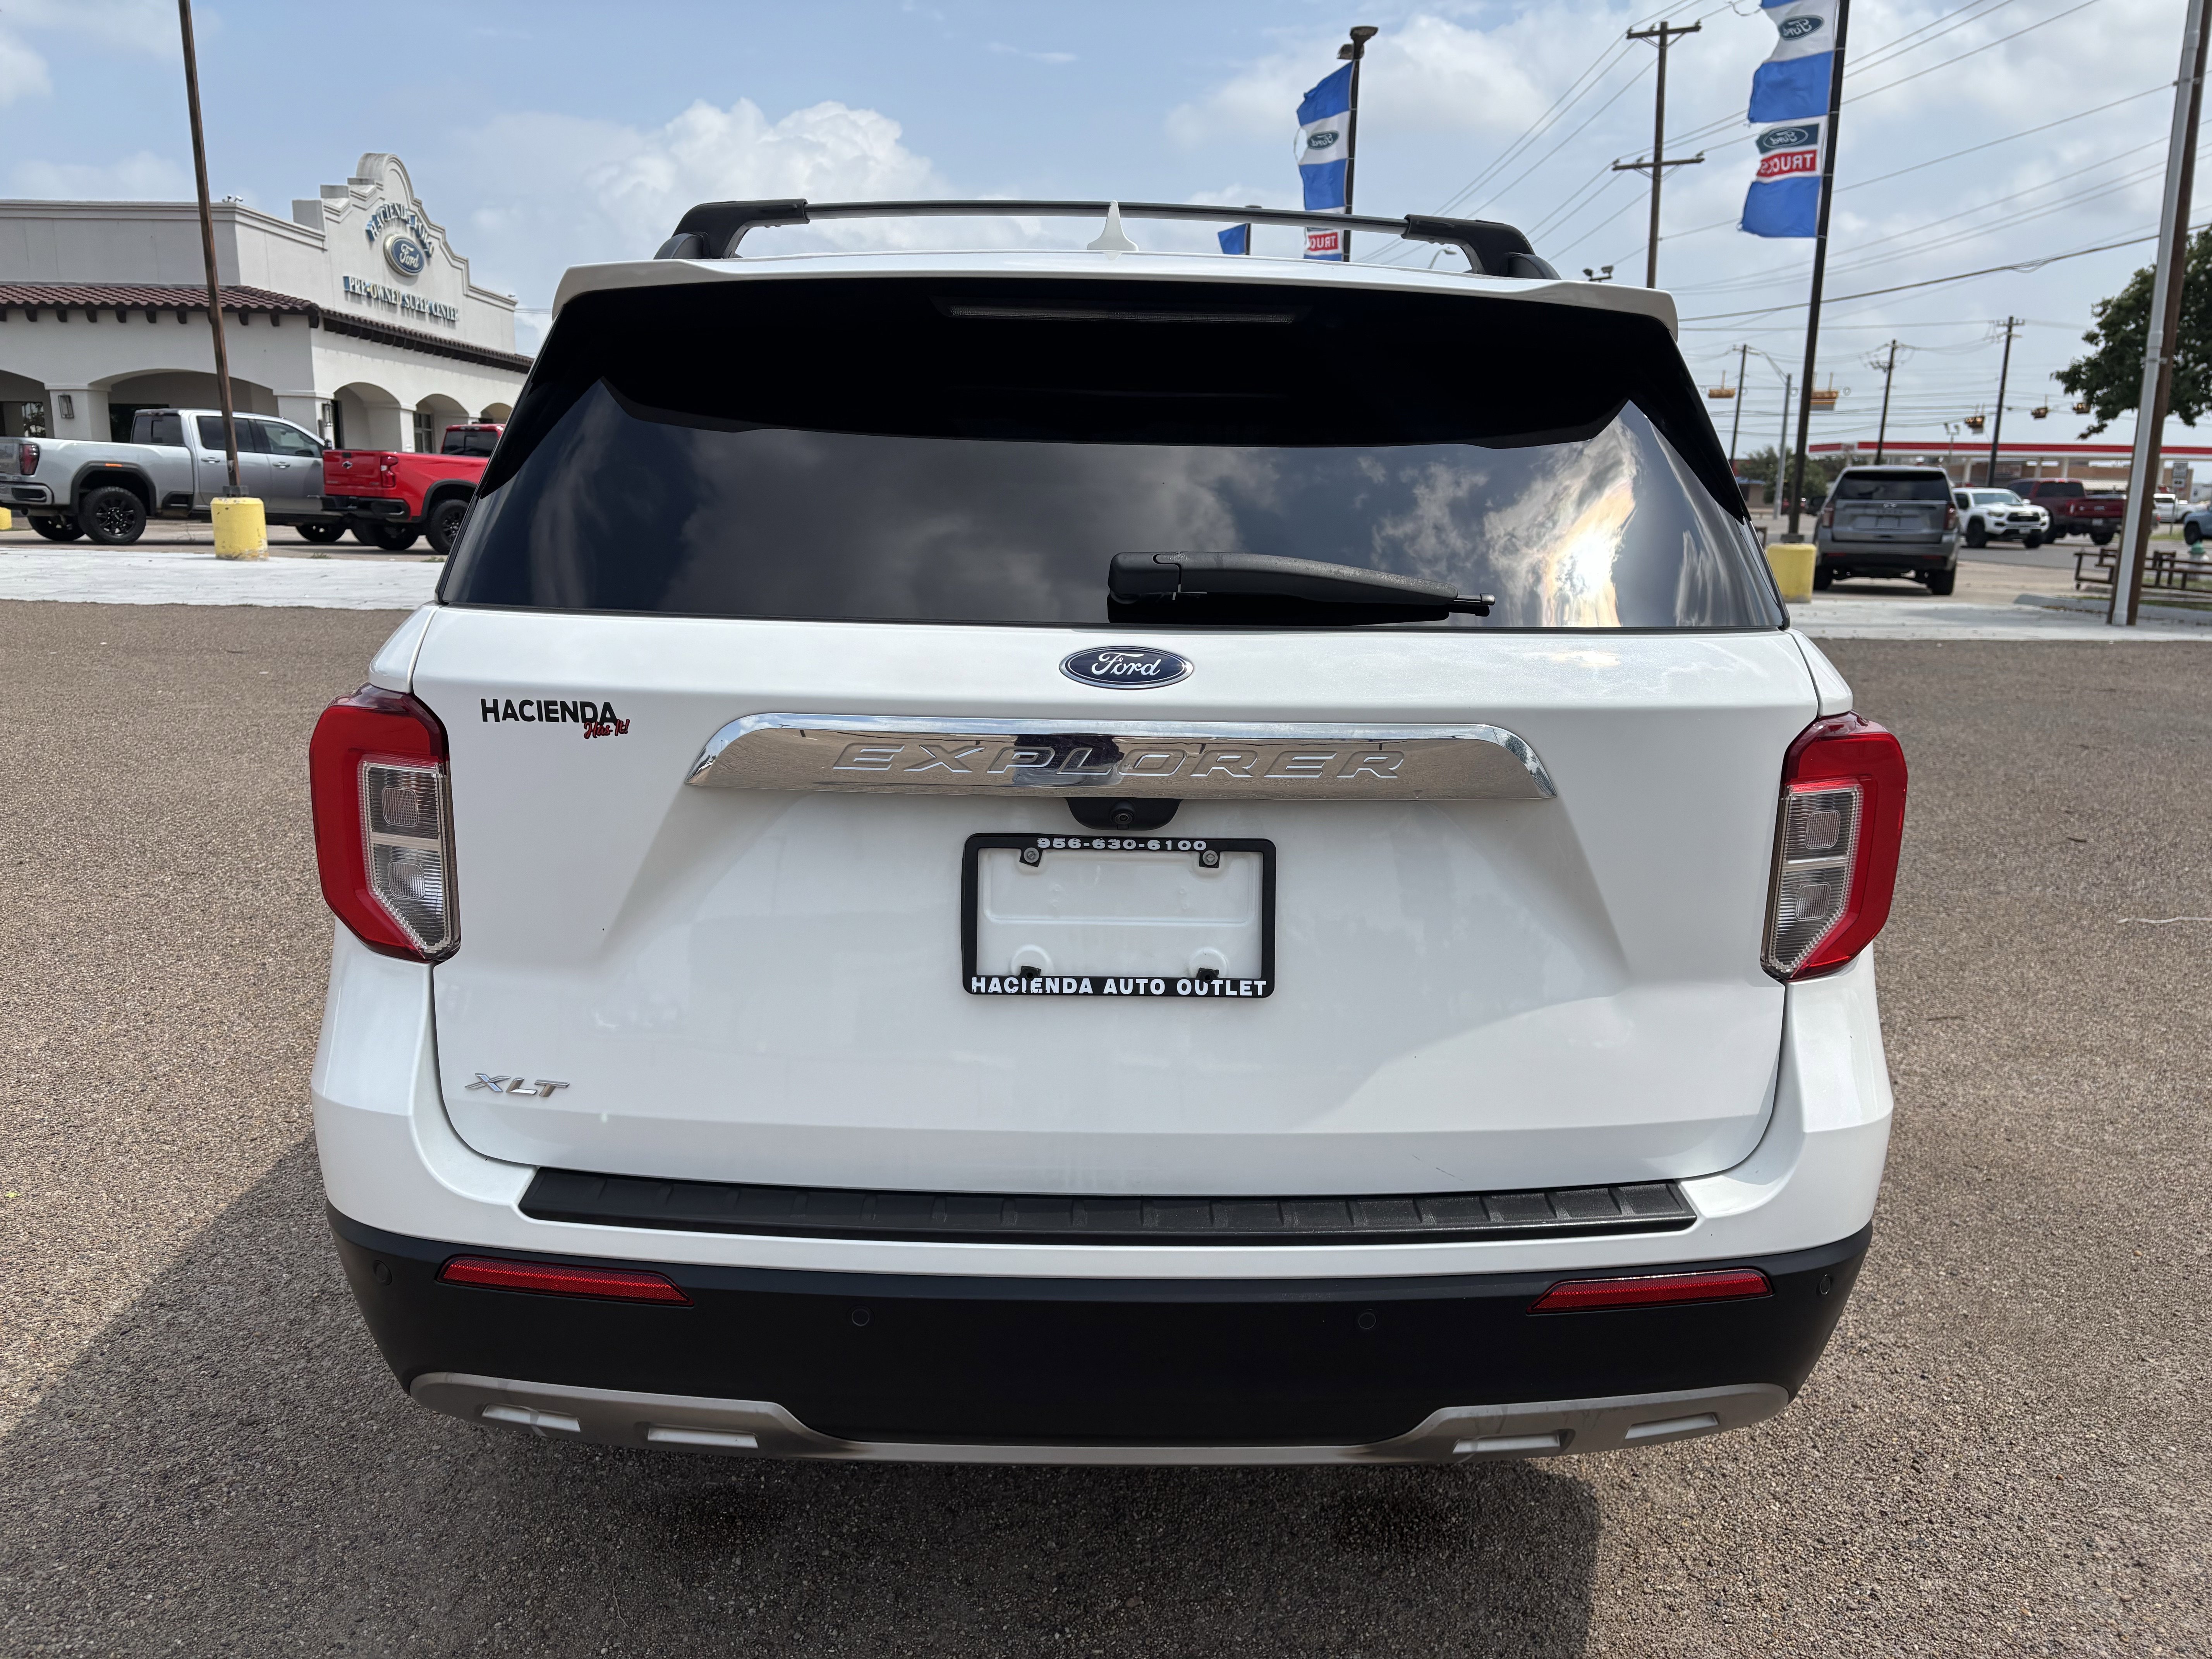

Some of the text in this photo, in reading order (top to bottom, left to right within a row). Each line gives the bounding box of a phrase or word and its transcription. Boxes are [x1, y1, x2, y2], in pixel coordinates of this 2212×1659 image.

[399, 243, 419, 268] Ford
[1091, 652, 1161, 676] Ford
[481, 698, 619, 726] HACIENDA
[584, 719, 630, 739] Has It!
[833, 742, 1403, 778] EXPLORER
[1037, 838, 1207, 850] 956-630-6100
[971, 977, 1267, 996] HACIENDA AUTO OUTLET
[464, 1073, 570, 1097] XLT
